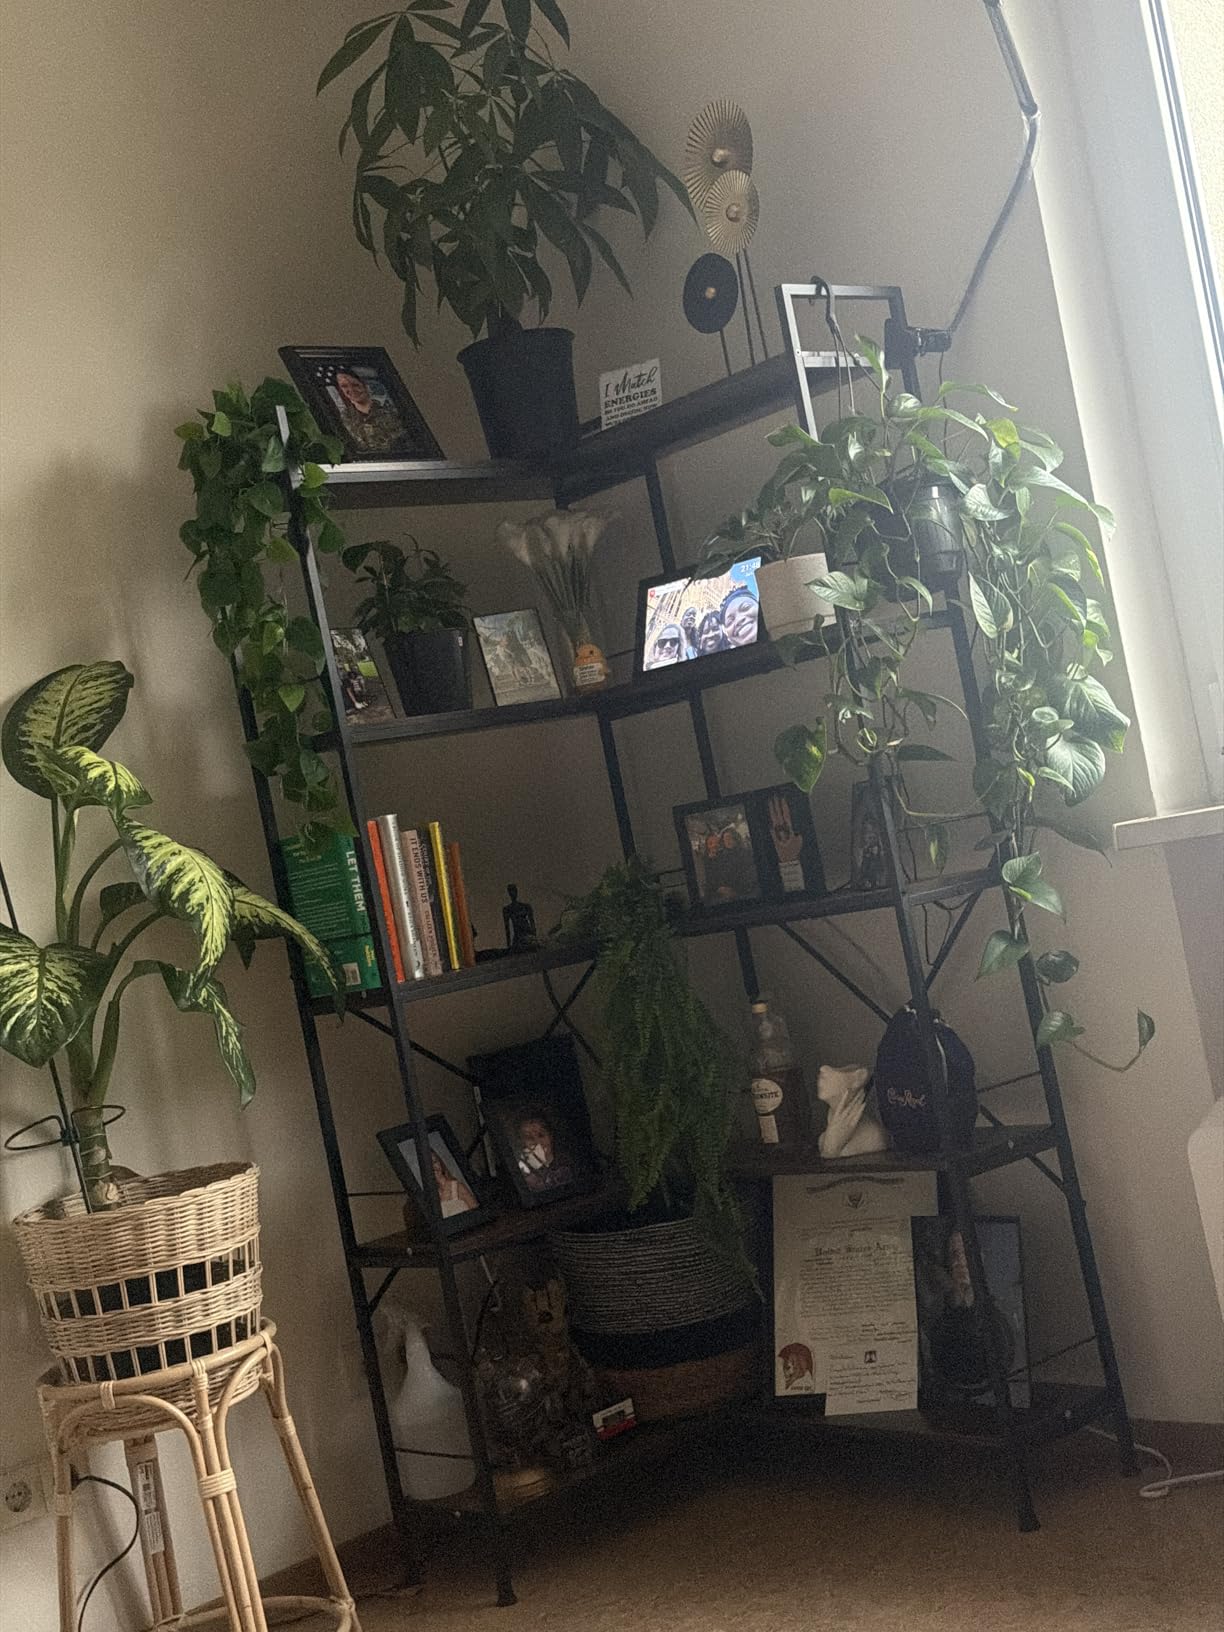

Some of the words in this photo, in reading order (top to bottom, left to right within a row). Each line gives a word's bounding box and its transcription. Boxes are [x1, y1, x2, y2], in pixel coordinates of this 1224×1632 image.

[615, 366, 658, 396] Match
[604, 388, 657, 408] ENERGIES
[411, 846, 422, 869] ENDS
[345, 850, 358, 877] LET
[352, 876, 366, 912] THEM
[416, 869, 426, 891] WITH
[421, 891, 430, 904] US
